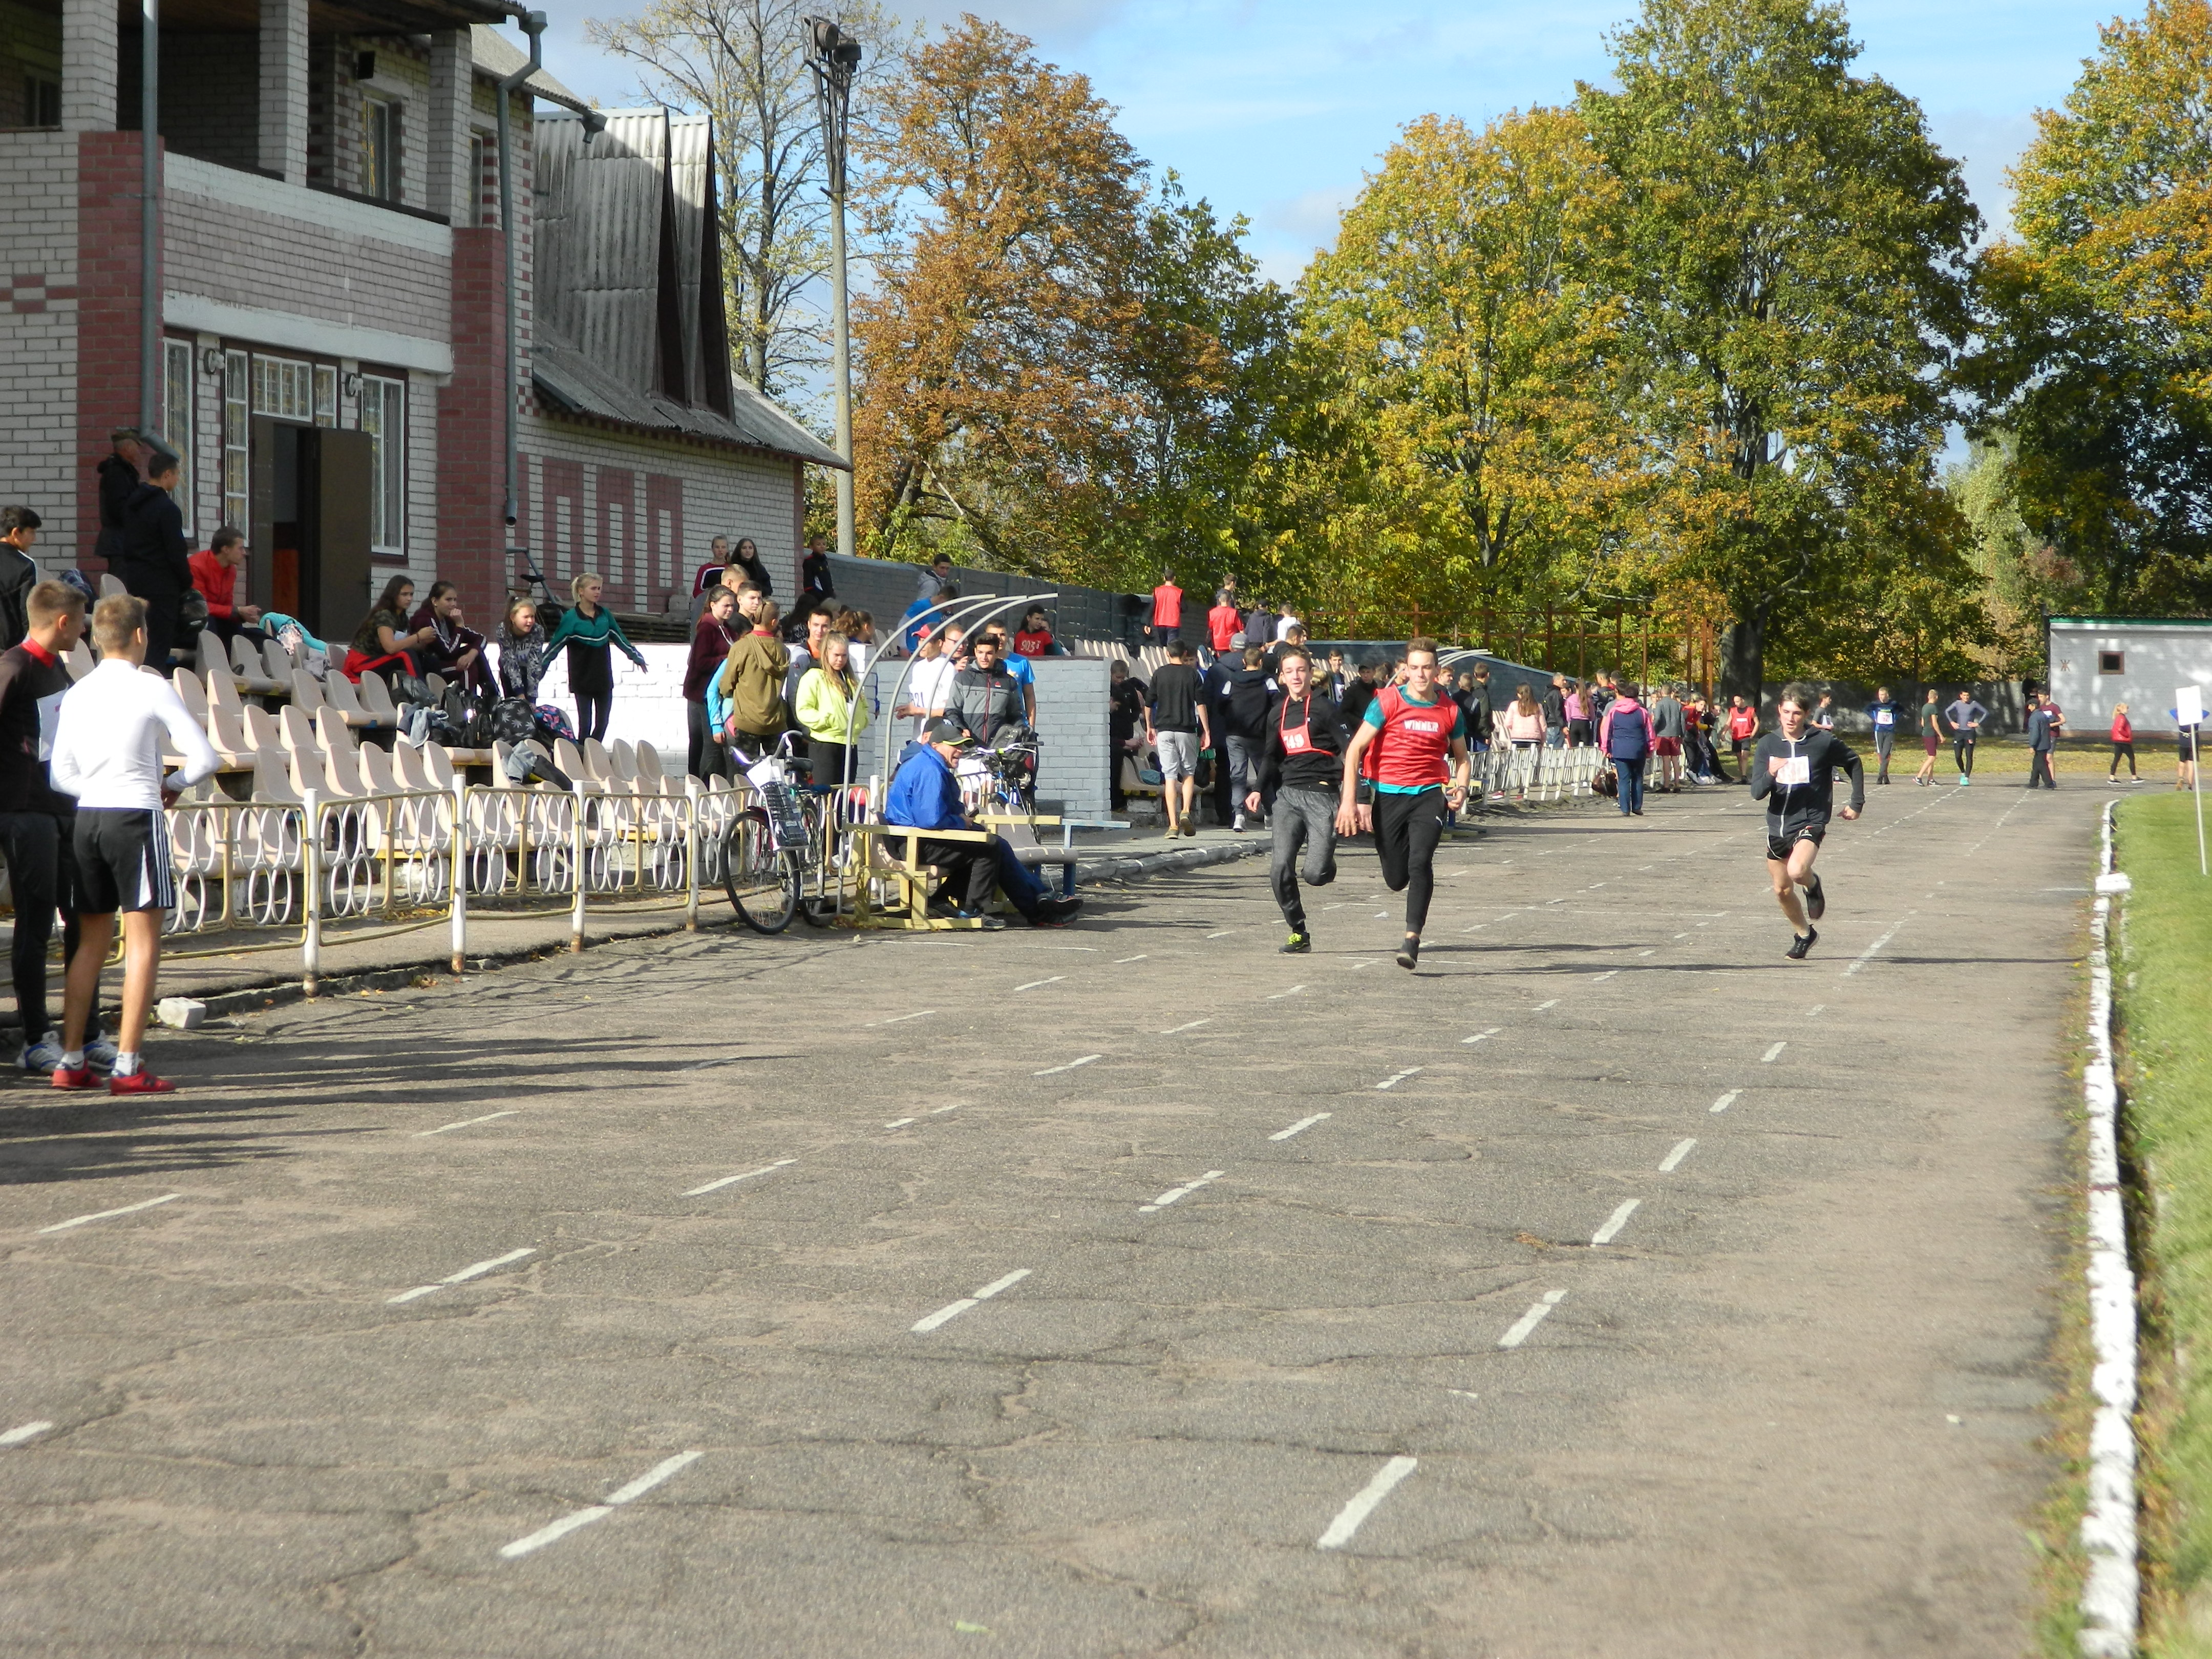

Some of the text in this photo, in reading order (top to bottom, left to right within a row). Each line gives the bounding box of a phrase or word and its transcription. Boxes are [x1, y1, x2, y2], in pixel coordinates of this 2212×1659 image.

[2060, 660, 2070, 672] Ж
[1404, 720, 1439, 732] WINNER
[1283, 733, 1304, 749] 749
